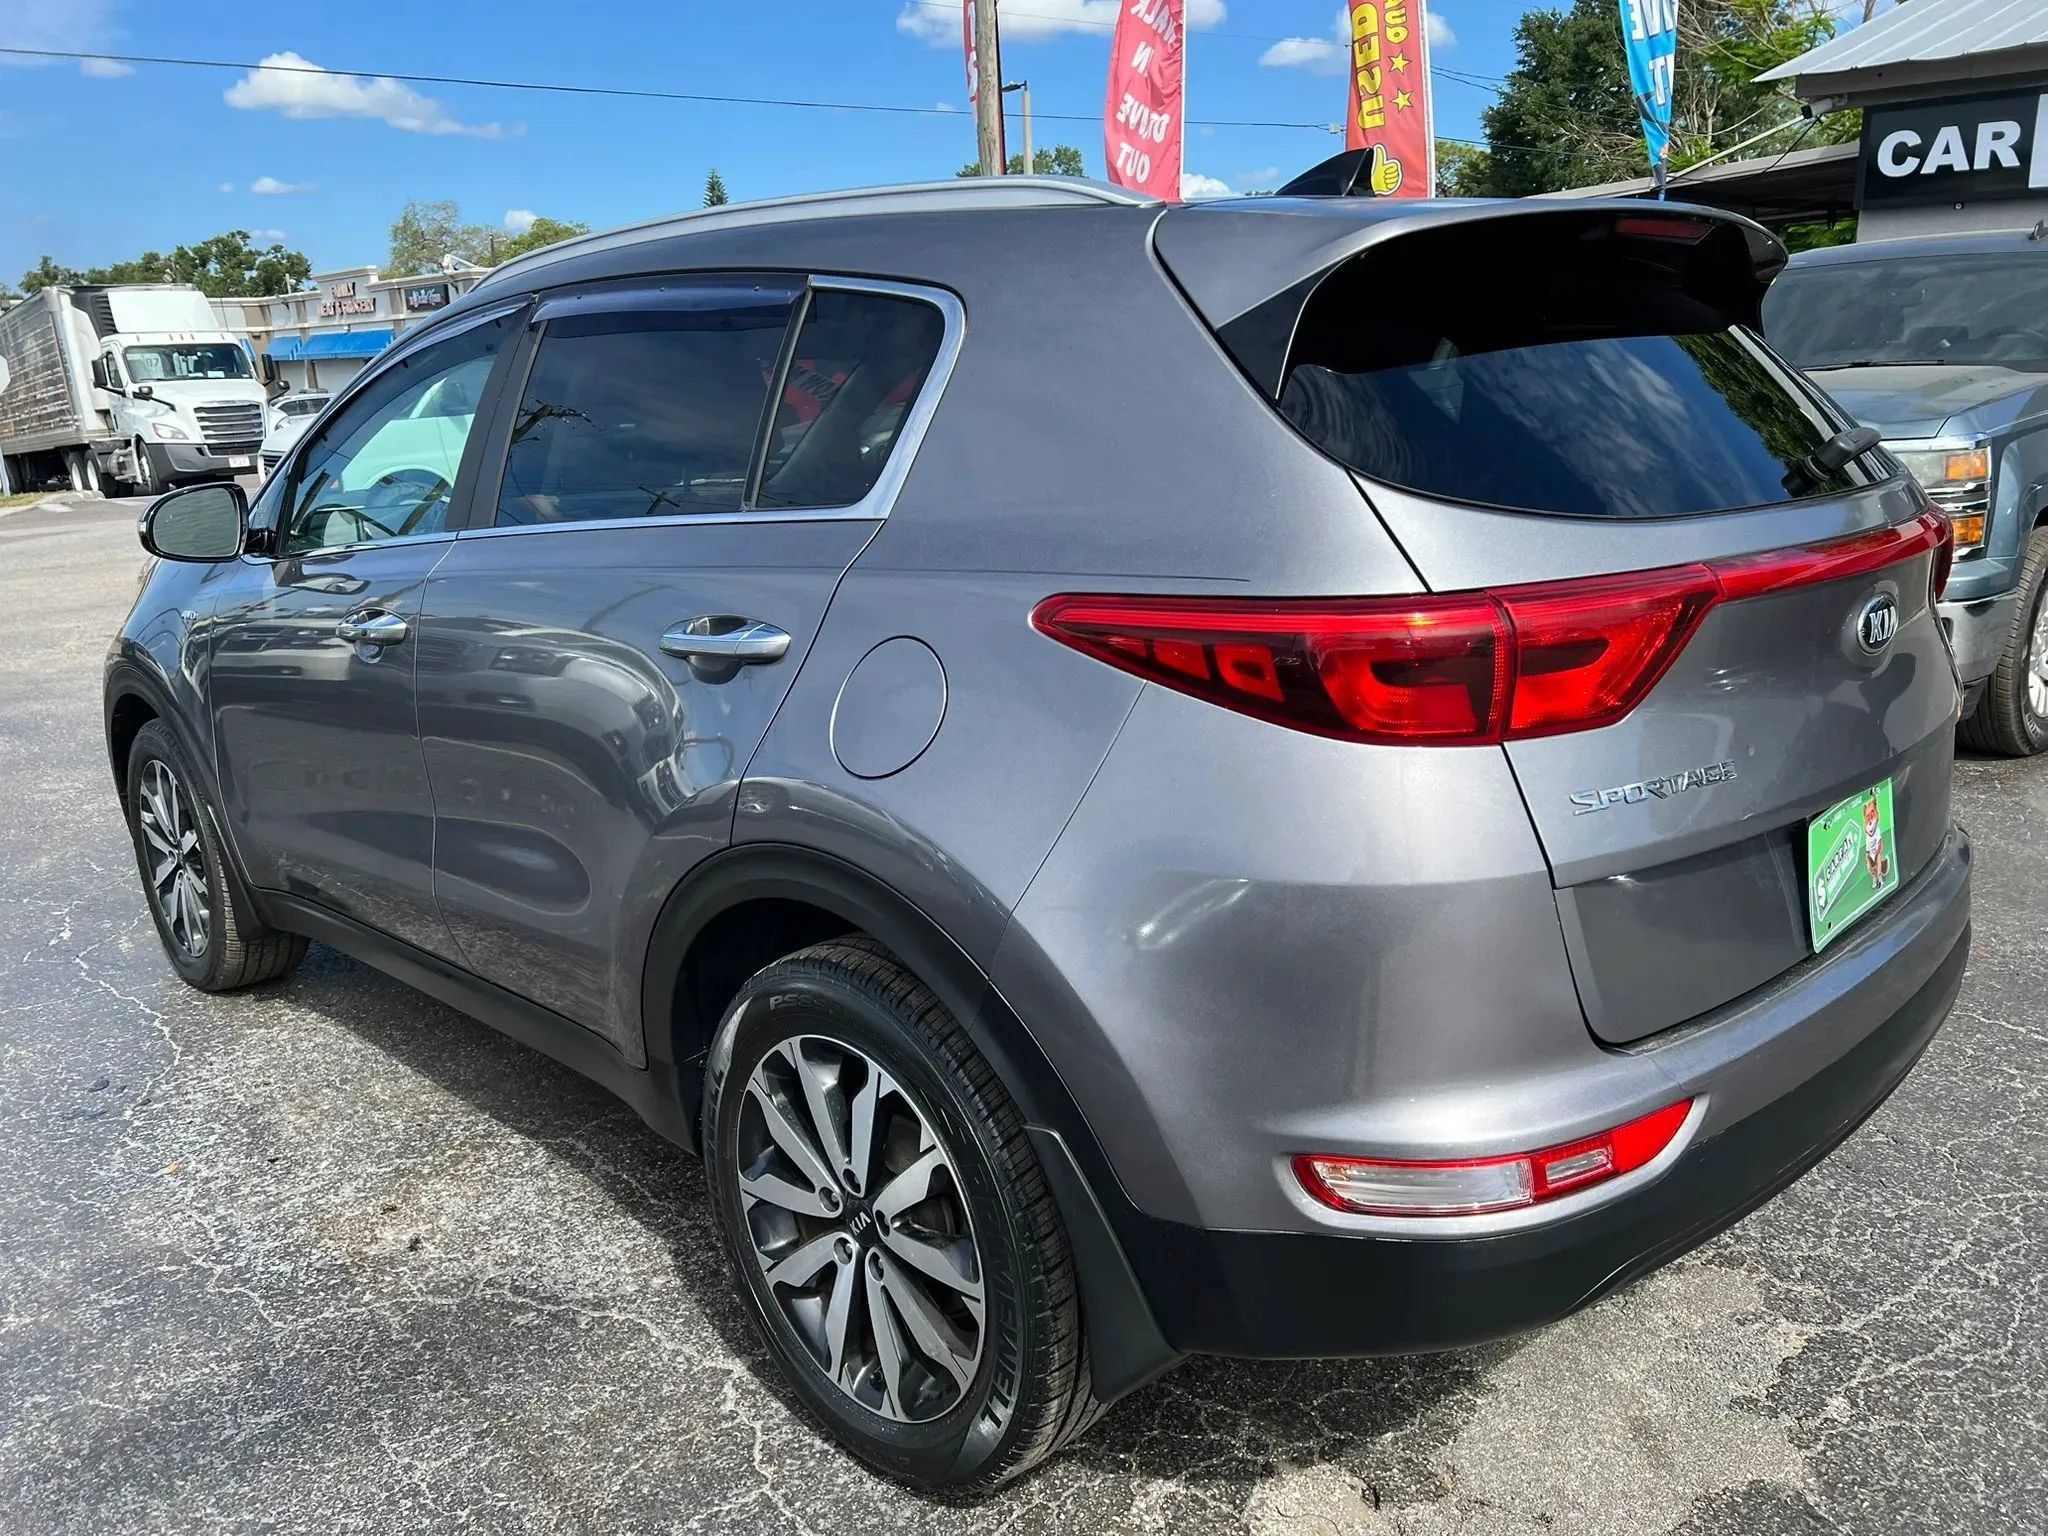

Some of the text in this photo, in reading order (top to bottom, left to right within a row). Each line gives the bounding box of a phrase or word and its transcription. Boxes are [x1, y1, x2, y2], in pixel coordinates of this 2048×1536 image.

[1877, 120, 2022, 178] CAR
[1869, 606, 1897, 643] KIA
[1569, 760, 1737, 816] SPORTAGE
[850, 1211, 871, 1236] KIA
